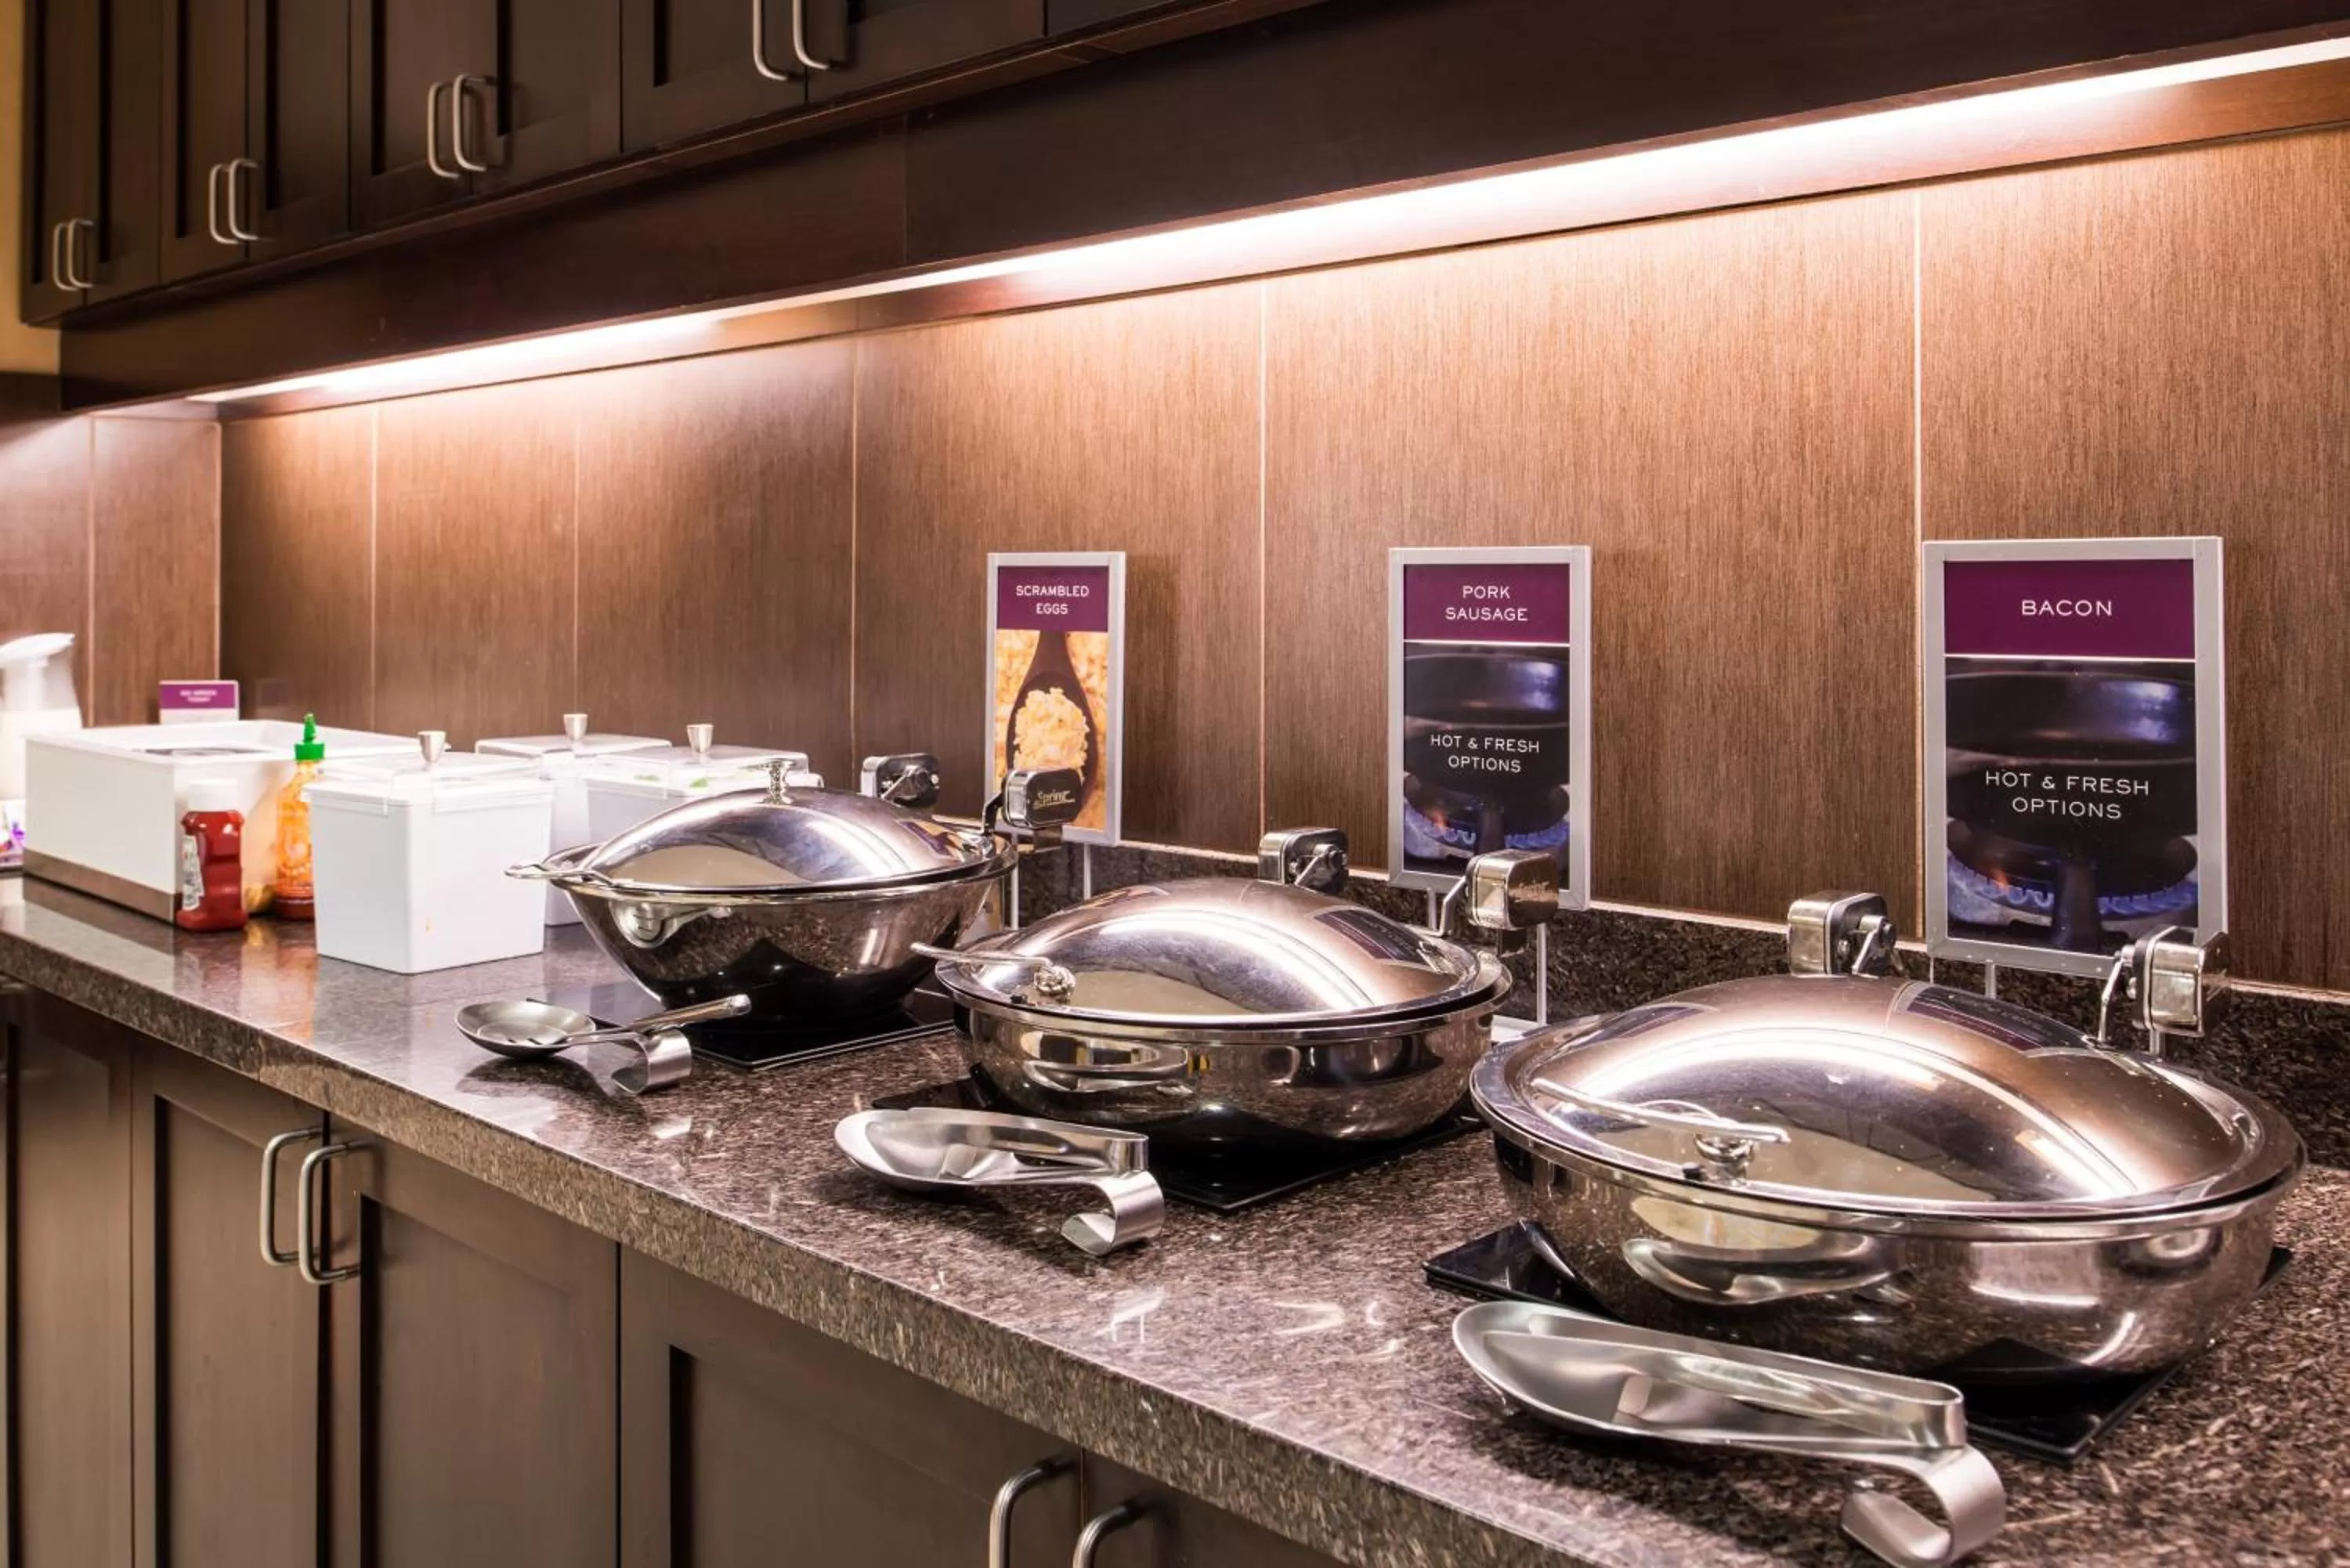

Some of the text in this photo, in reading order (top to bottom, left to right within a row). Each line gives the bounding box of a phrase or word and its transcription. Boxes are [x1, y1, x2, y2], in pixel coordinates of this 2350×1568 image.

[1016, 585, 1090, 598] SCRAMBLED
[1462, 585, 1510, 599] PORK
[1036, 602, 1068, 615] EGGS
[1445, 606, 1528, 622] SAUSAGE
[2021, 599, 2113, 616] BACON
[1430, 734, 1540, 753] HOT & FRESH
[1448, 754, 1521, 773] OPTIONS
[1985, 770, 2149, 796] HOT & FRESH
[2012, 797, 2122, 820] OPTIONS
